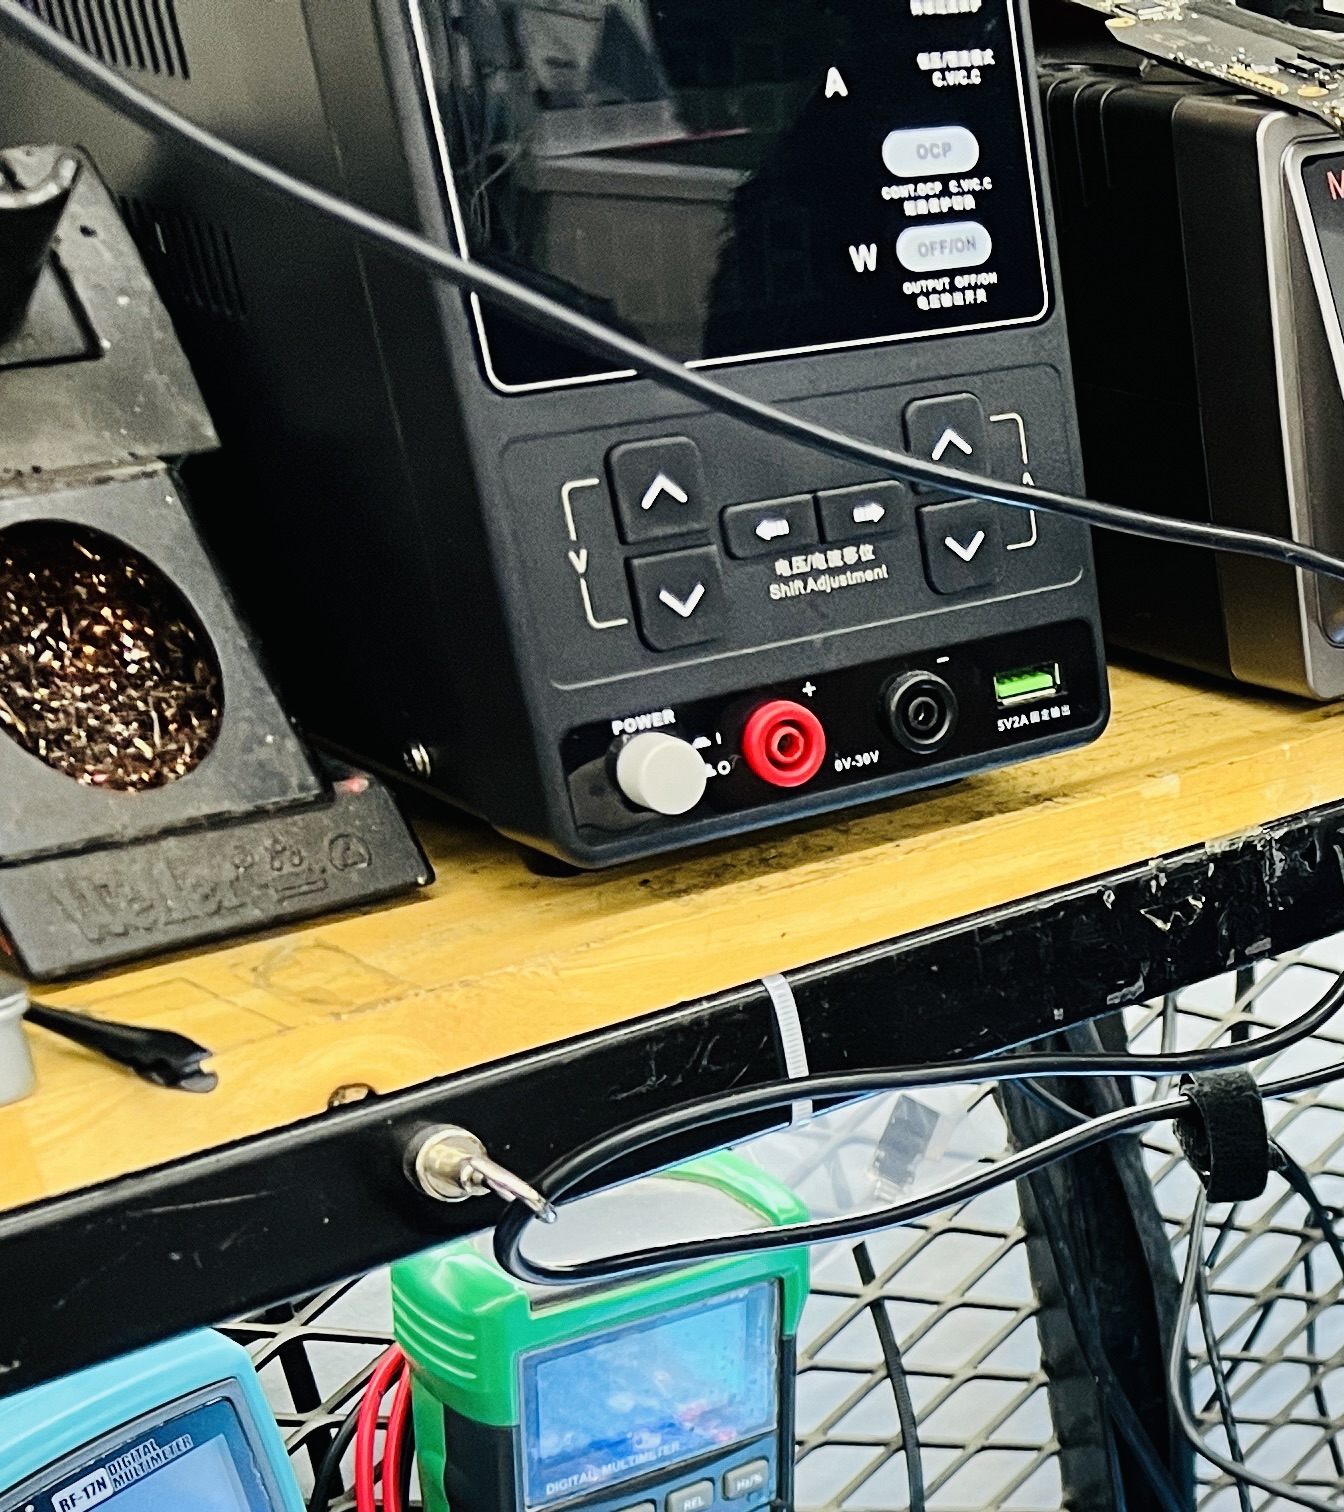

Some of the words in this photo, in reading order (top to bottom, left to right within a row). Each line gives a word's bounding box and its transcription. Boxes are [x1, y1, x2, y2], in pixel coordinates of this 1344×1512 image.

[825, 66, 848, 98] A
[916, 142, 952, 160] OCP
[848, 243, 878, 273] W
[917, 236, 977, 258] OFF/ON
[902, 276, 950, 295] OUTPUT
[569, 550, 588, 574] V
[611, 709, 677, 735] POWER
[107, 1438, 162, 1476] DIGITAL
[545, 1466, 600, 1495] DIGITAL
[601, 1441, 681, 1475] MULTIMETER
[59, 1476, 108, 1512] RF-17N
[113, 1434, 194, 1491] MULTIMETER
[683, 1496, 705, 1512] REL
